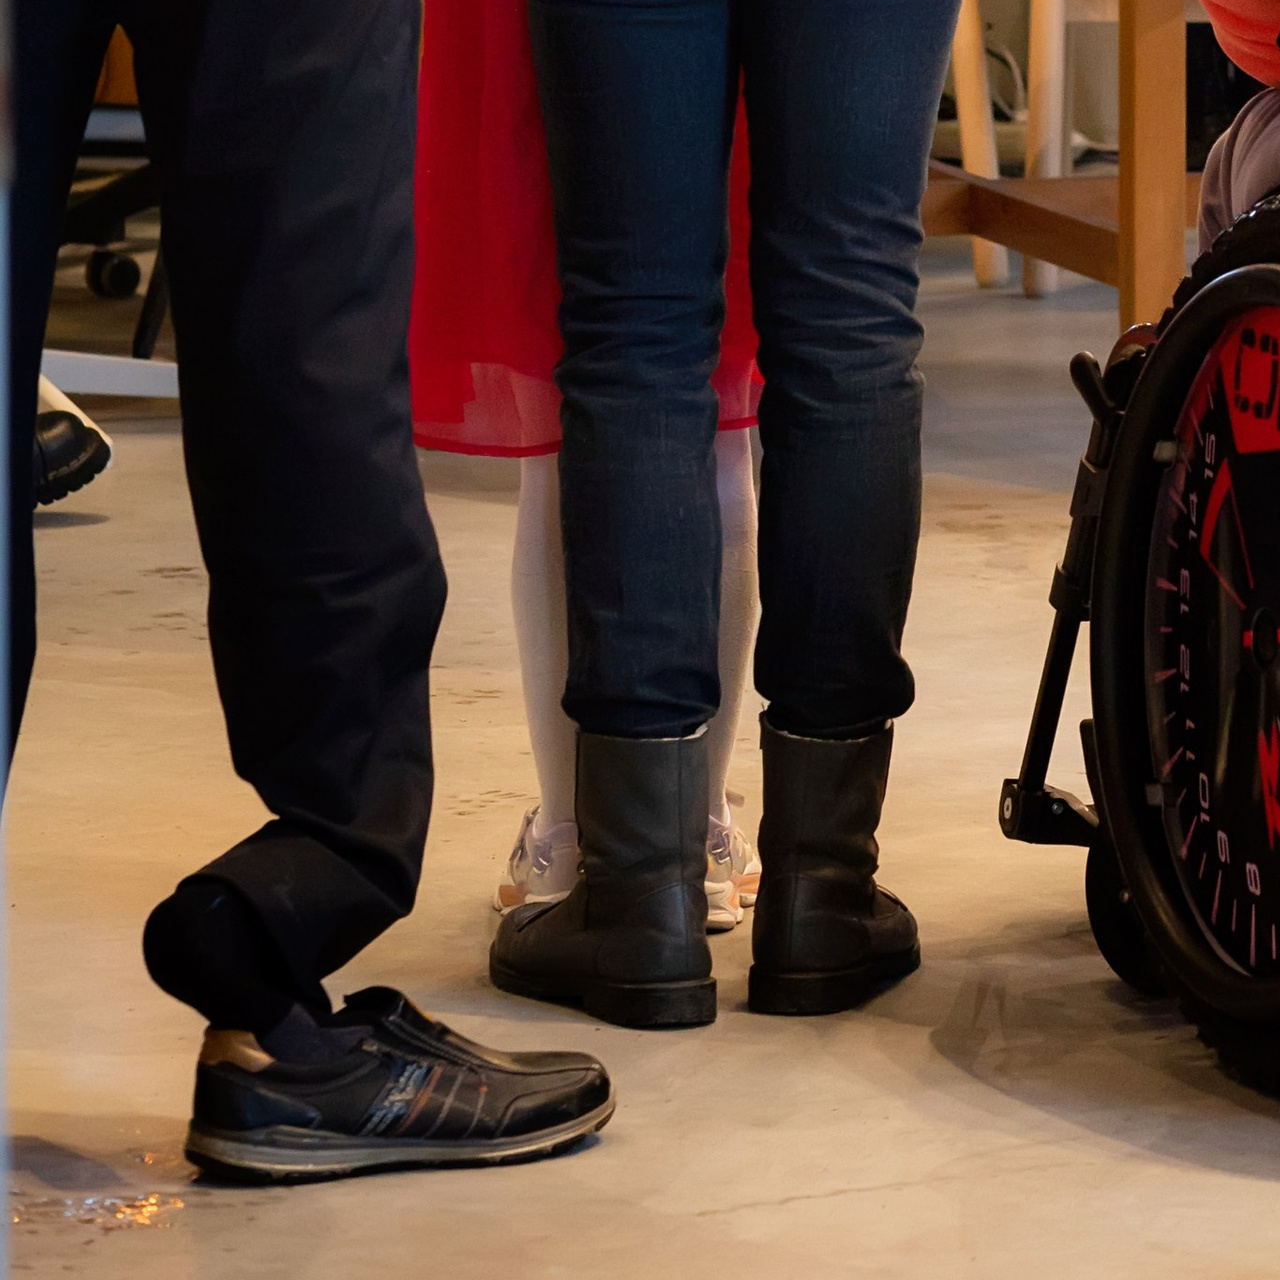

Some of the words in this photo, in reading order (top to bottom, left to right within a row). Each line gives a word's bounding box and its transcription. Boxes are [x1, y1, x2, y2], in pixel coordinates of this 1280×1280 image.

[1204, 432, 1217, 480] 15
[1188, 491, 1199, 540] 14
[1179, 567, 1191, 615] 13
[1179, 643, 1191, 693] 12
[1185, 717, 1197, 762] 11
[1199, 772, 1211, 823] 10
[1216, 829, 1231, 864] 9
[1245, 861, 1262, 897] 8
